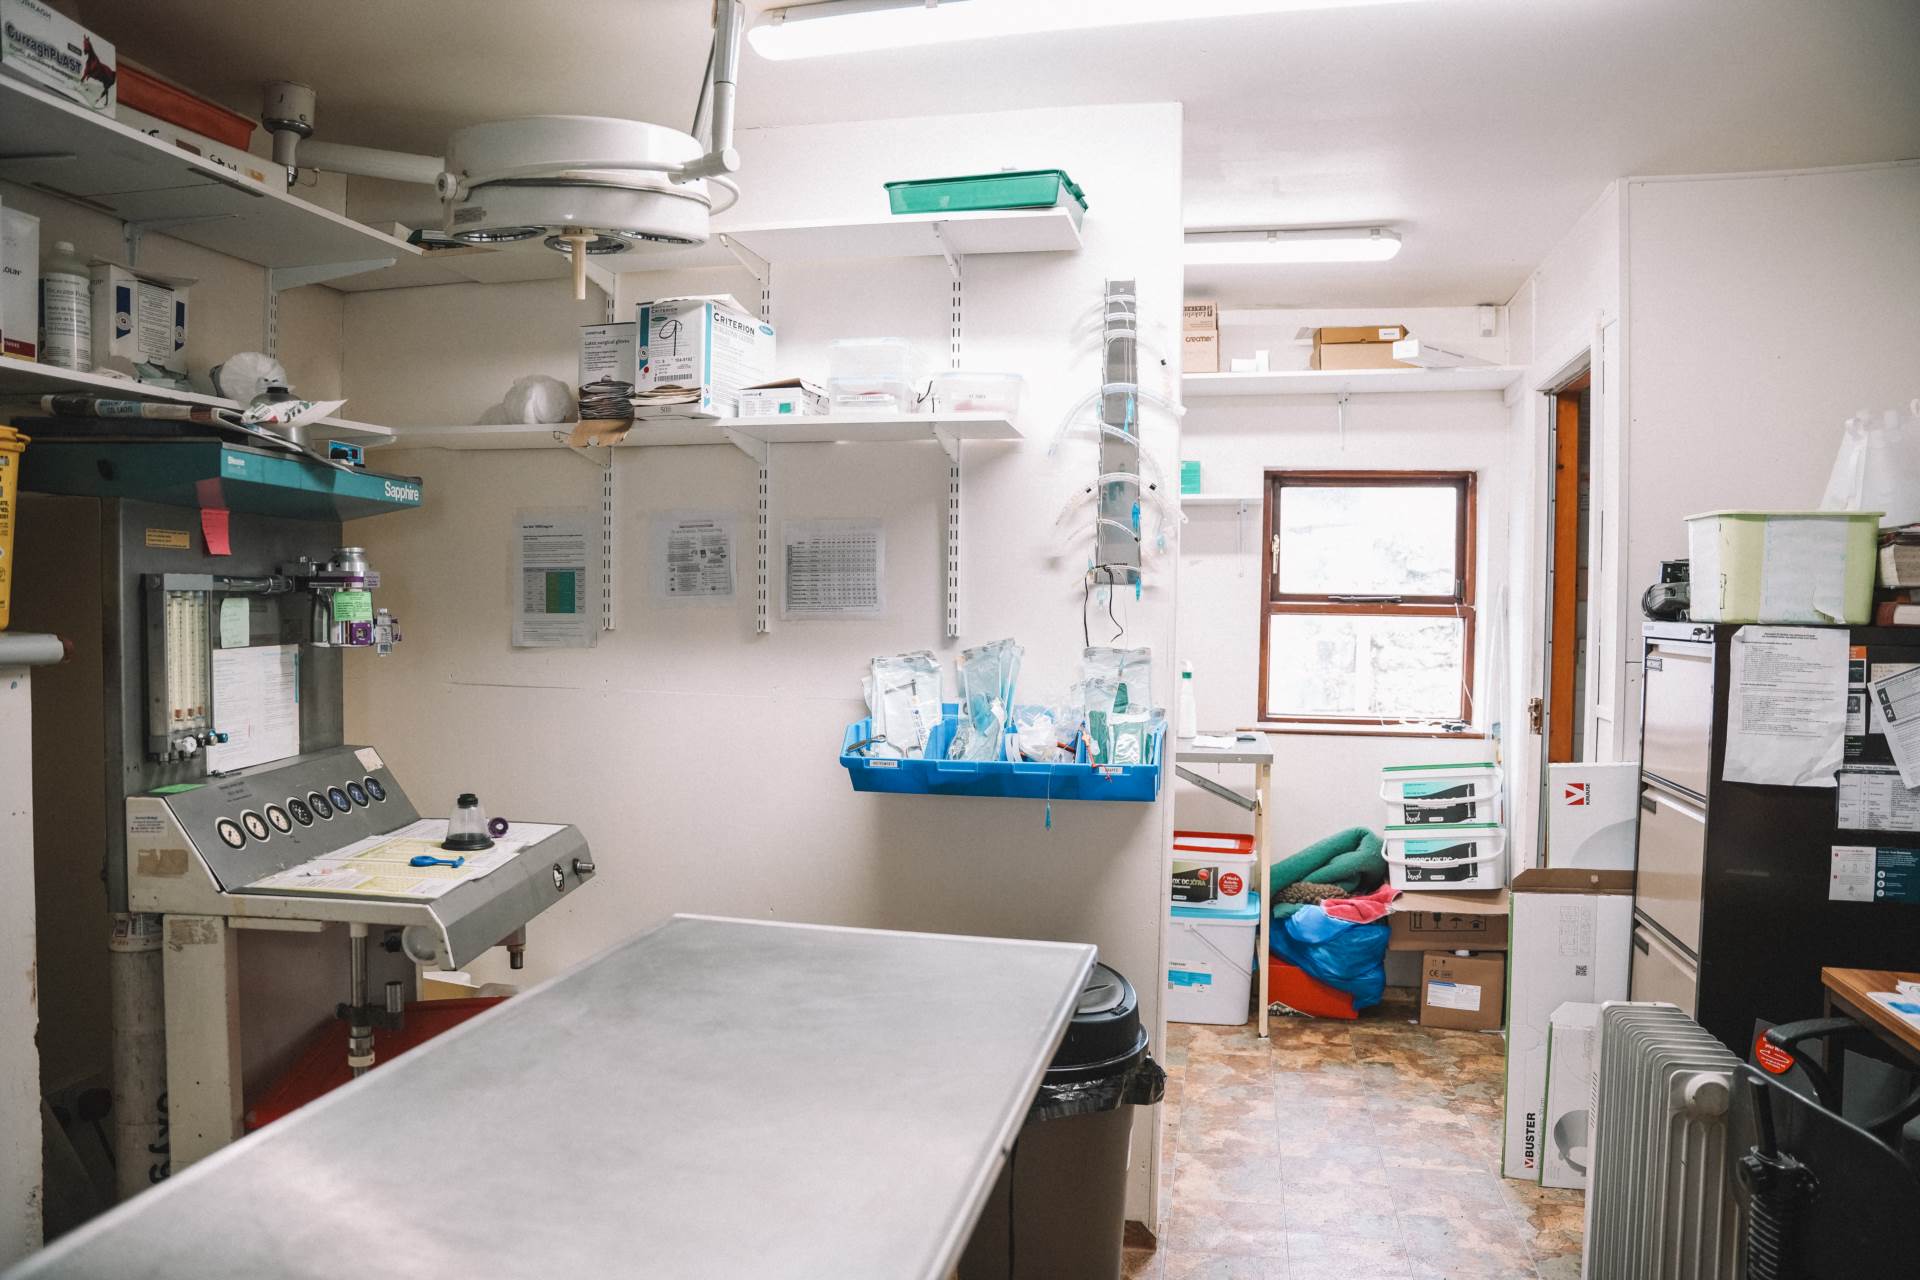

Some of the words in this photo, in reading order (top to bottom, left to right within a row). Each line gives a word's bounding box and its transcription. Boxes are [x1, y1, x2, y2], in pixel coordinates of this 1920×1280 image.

[713, 312, 755, 336] CRITERION
[384, 481, 419, 502] Sapphire
[1525, 1112, 1536, 1158] BUSTER
